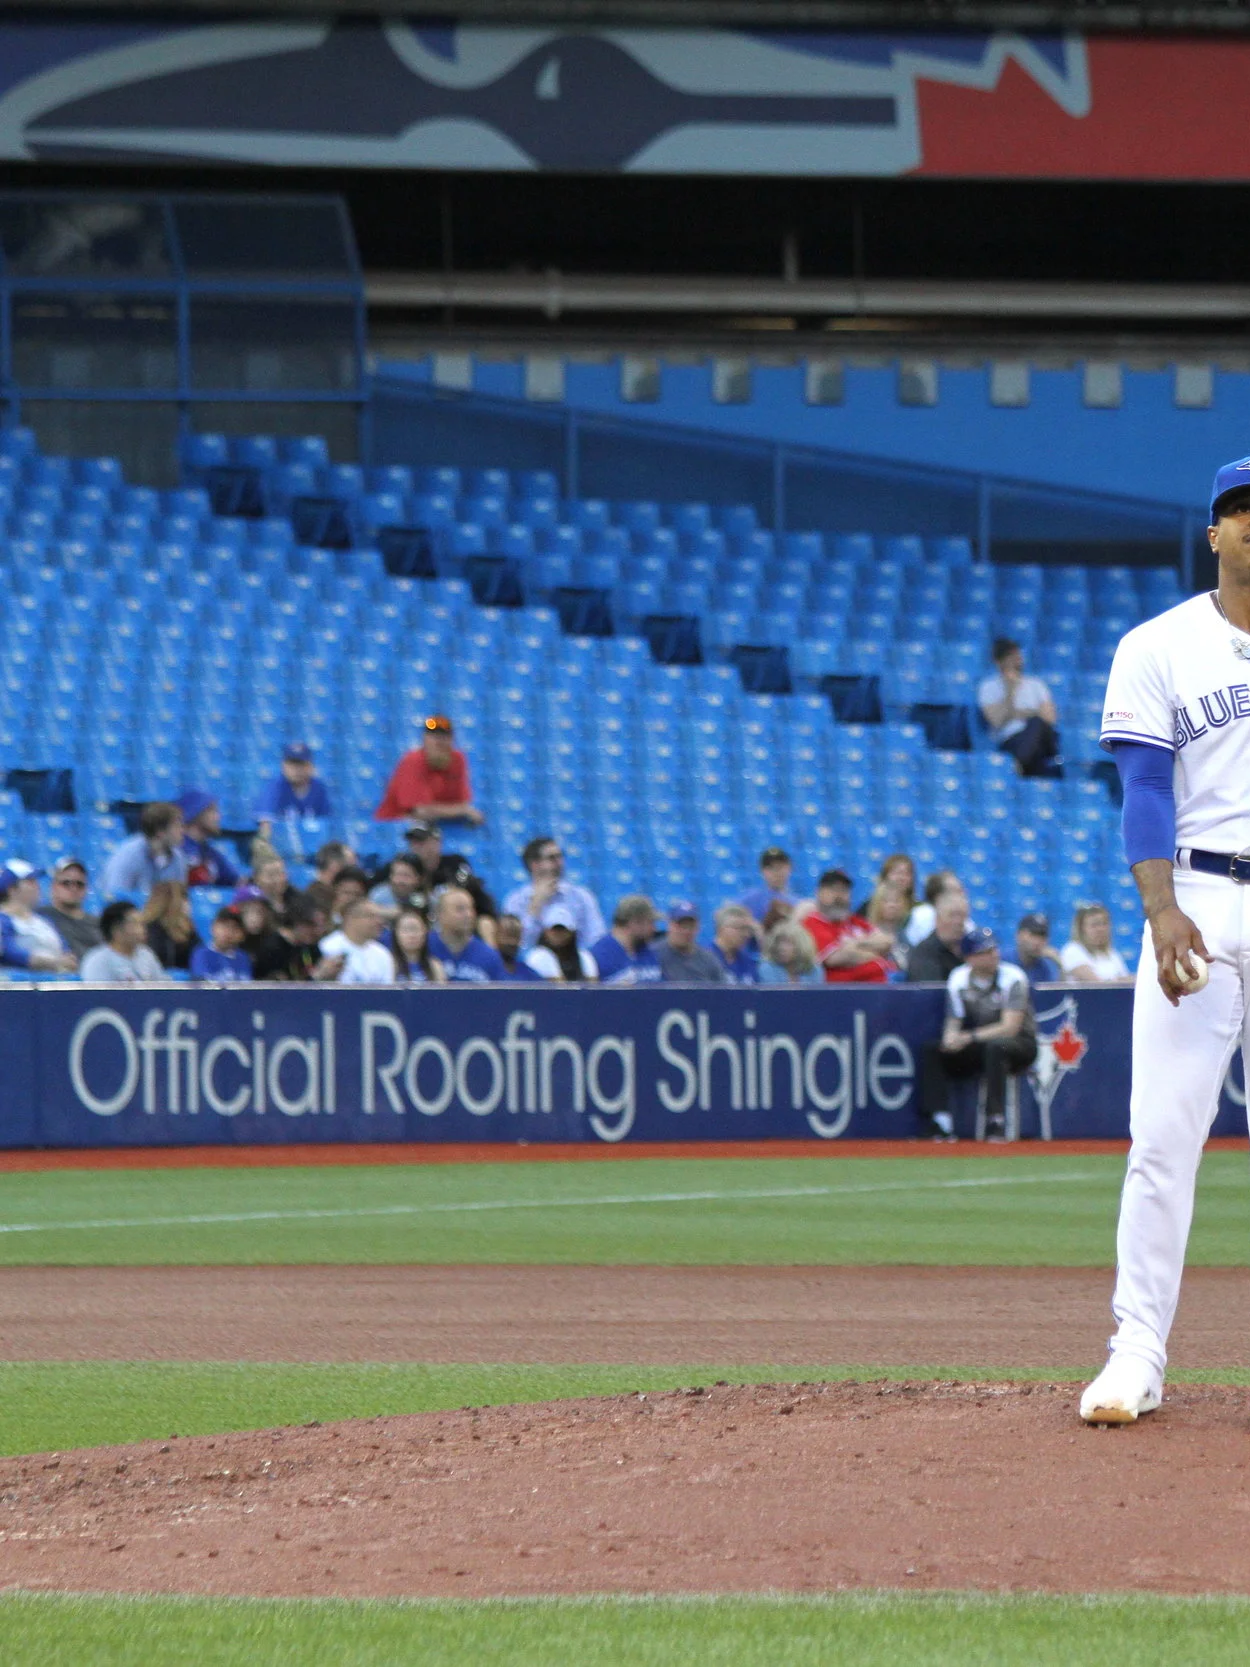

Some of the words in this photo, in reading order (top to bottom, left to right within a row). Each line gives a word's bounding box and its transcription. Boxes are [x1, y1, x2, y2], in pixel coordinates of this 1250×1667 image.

[69, 1008, 337, 1117] Official
[361, 1009, 637, 1142] Roofing
[655, 1009, 915, 1139] Shingle
